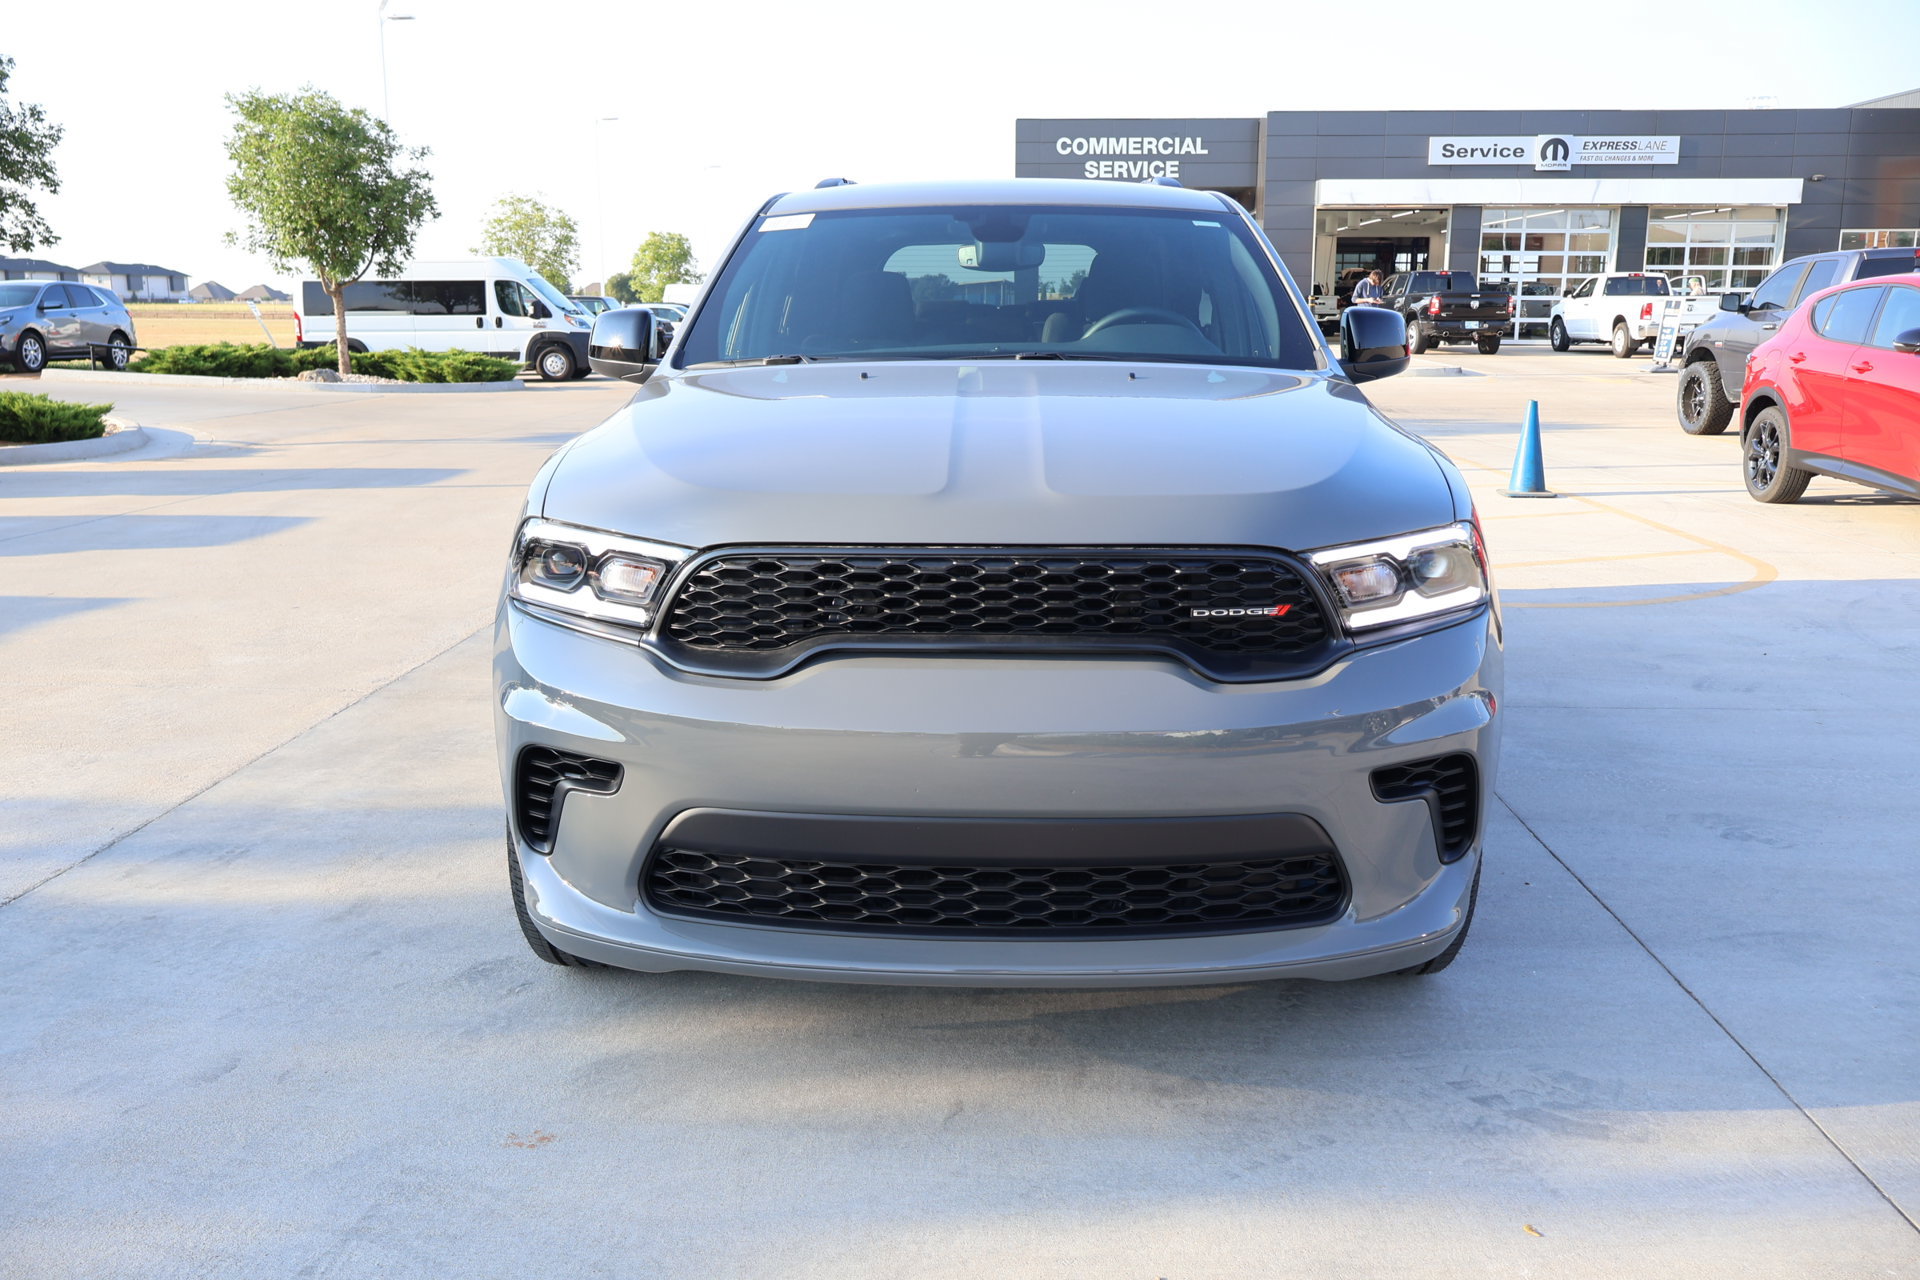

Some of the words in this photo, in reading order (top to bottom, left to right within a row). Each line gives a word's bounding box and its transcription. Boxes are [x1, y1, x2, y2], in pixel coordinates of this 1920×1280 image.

[1056, 137, 1208, 155] COMMERCIAL
[1441, 143, 1525, 158] Service
[1084, 160, 1179, 178] SERVICE
[1192, 607, 1279, 617] DODGE
